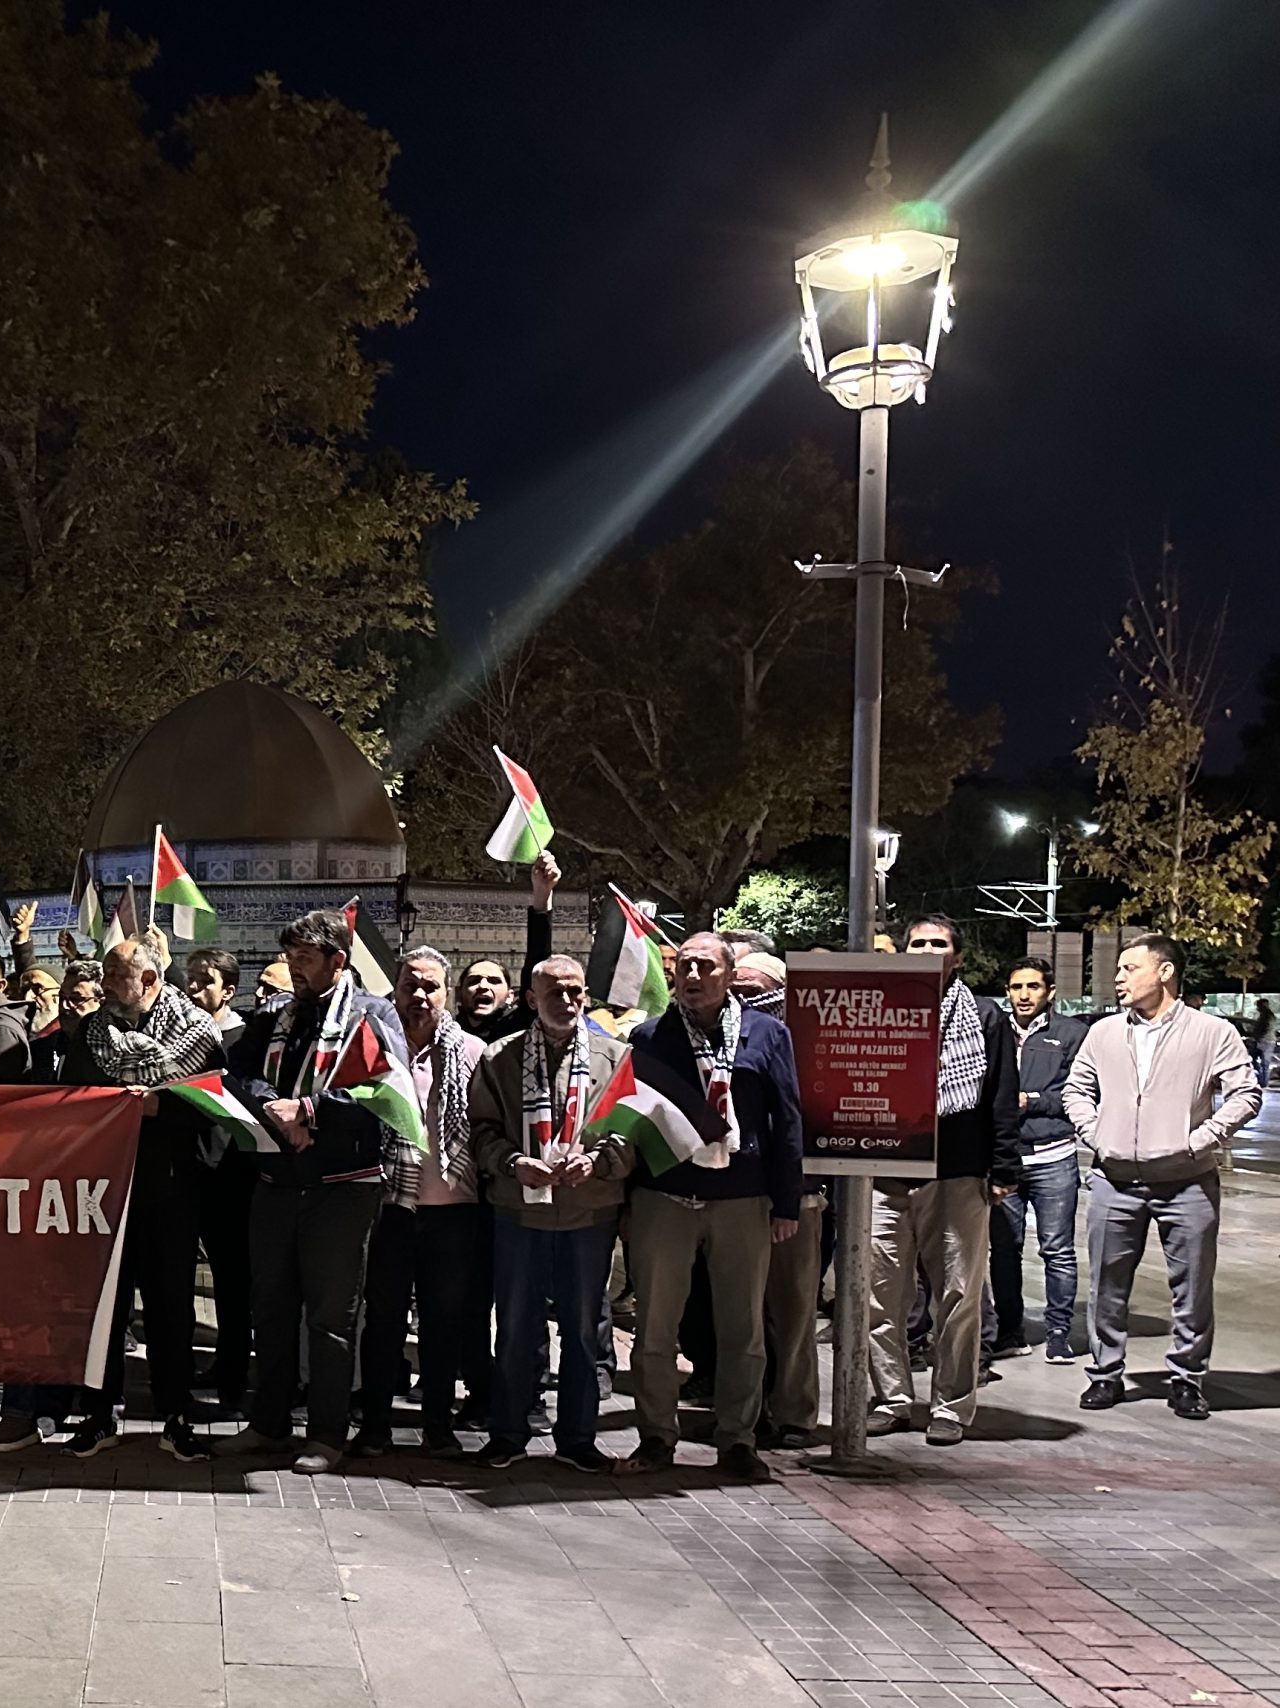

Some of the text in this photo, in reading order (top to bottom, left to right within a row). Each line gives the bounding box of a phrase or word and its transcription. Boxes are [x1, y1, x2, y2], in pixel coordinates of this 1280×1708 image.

[796, 989, 885, 1009] YA ZAFER
[817, 1007, 932, 1029] YA ŞEHADET
[861, 1044, 907, 1056] PAZARTESİ
[853, 1082, 880, 1093] 19.30
[829, 1137, 902, 1147] AGD MGV
